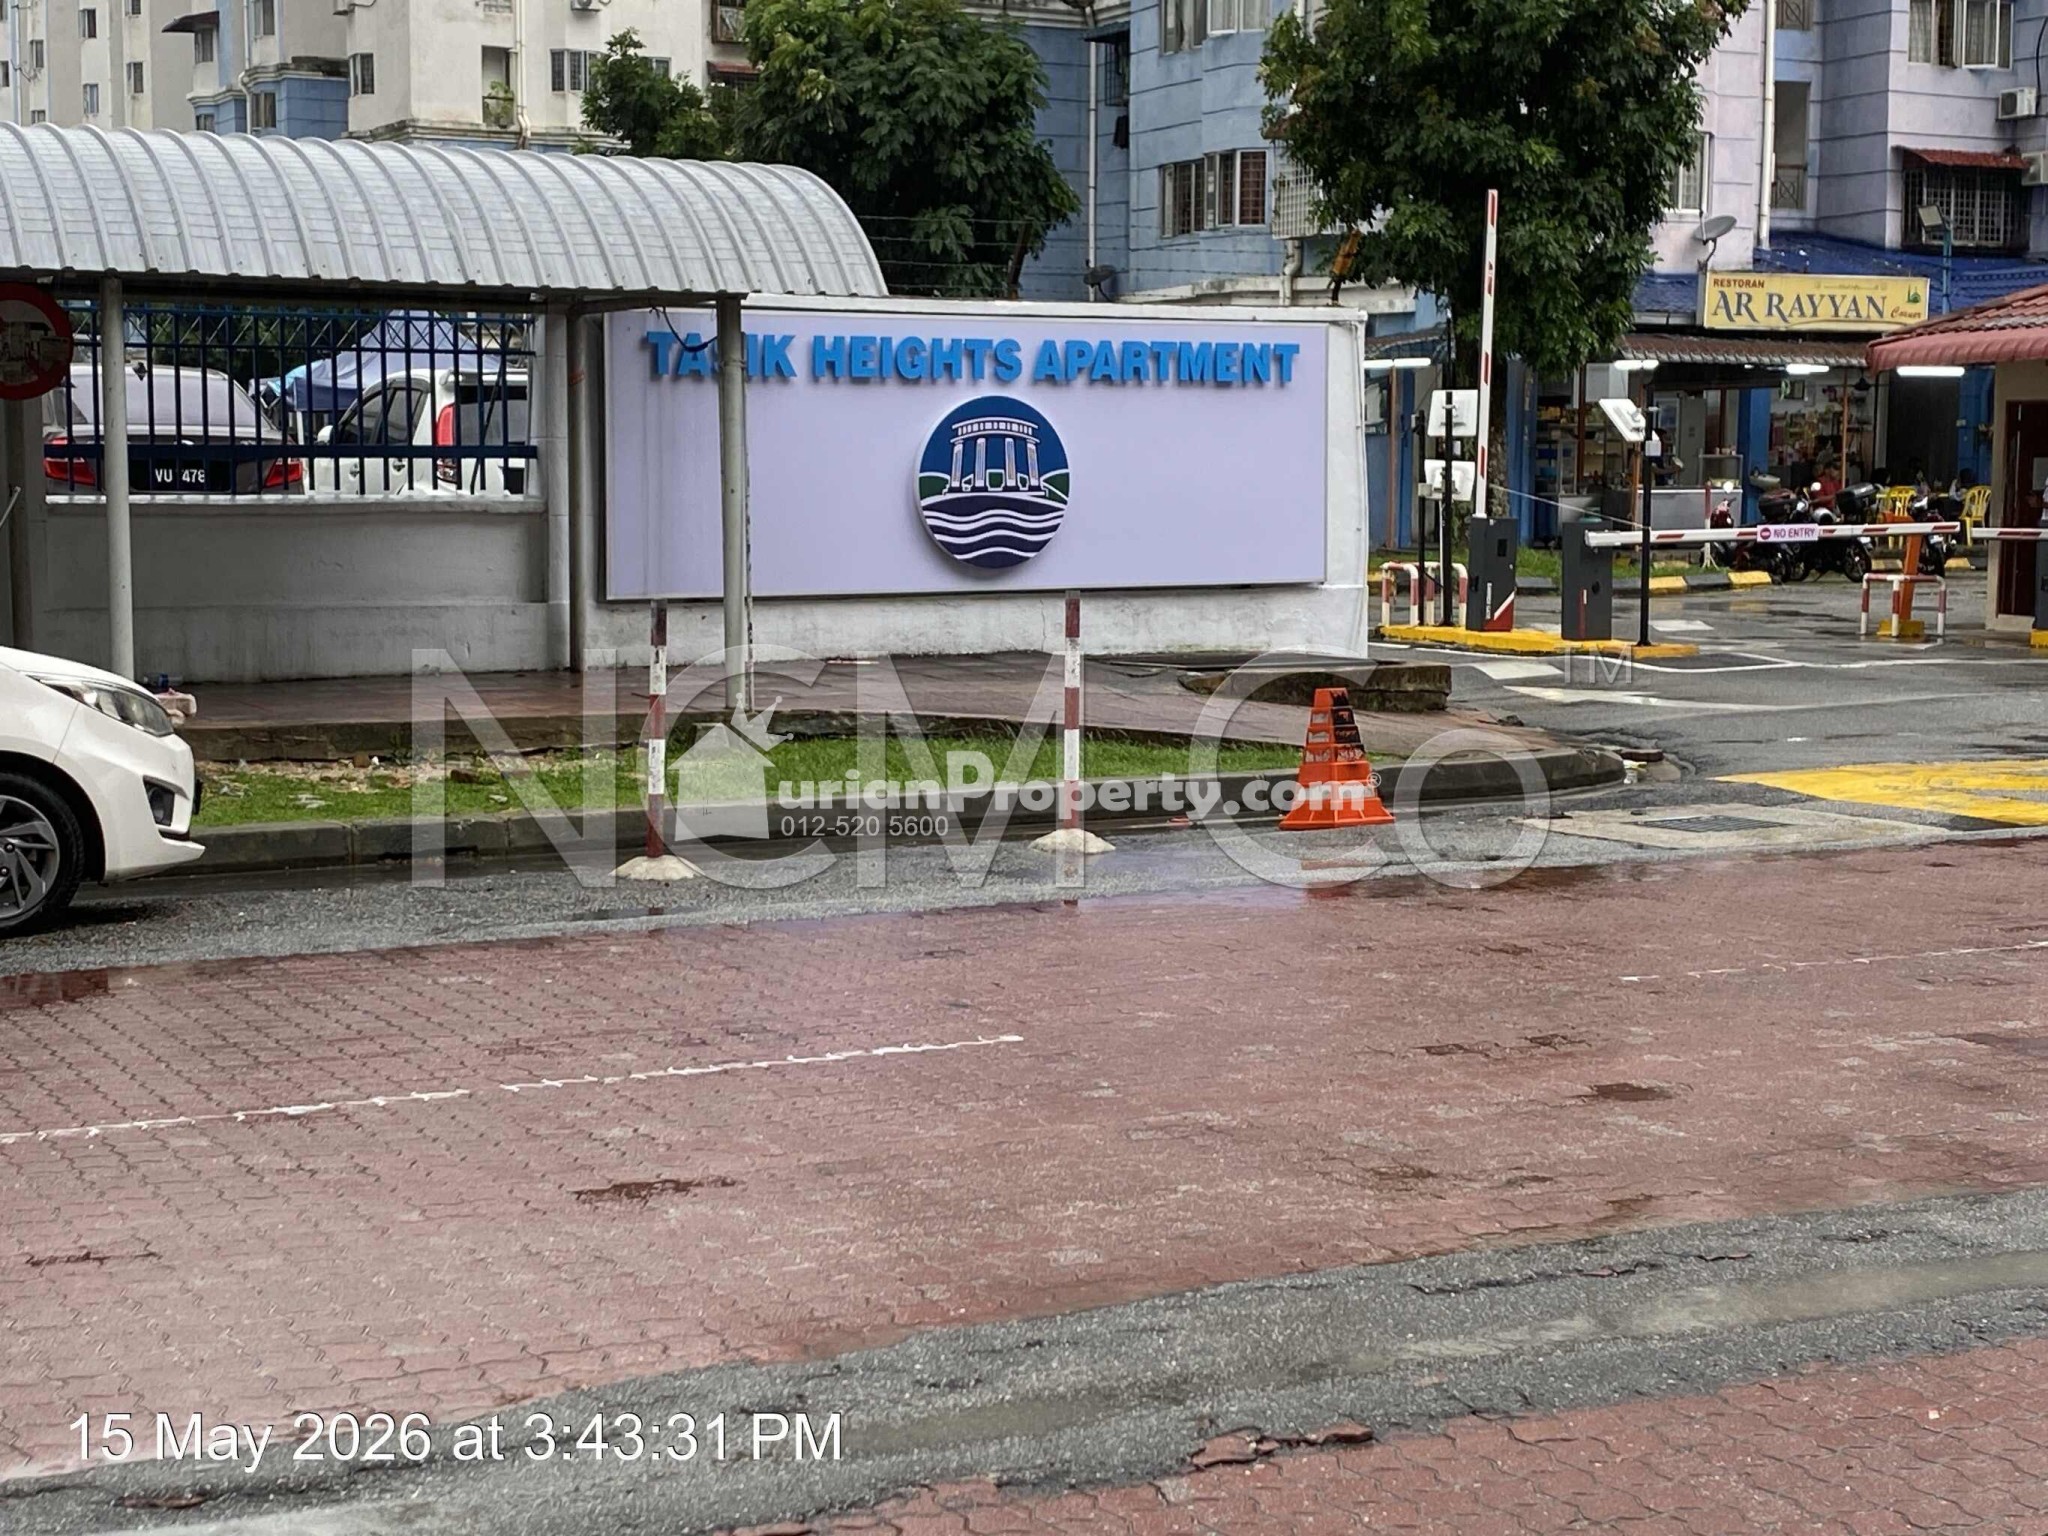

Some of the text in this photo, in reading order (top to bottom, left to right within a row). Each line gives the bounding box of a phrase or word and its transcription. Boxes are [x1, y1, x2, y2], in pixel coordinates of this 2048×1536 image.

[1712, 277, 1766, 289] RESTORAN
[1711, 290, 1888, 323] AR RAYYAN
[646, 331, 1300, 384] TAIK HEIGHTS APARTMENT
[1773, 527, 1816, 539] NO ENTRY
